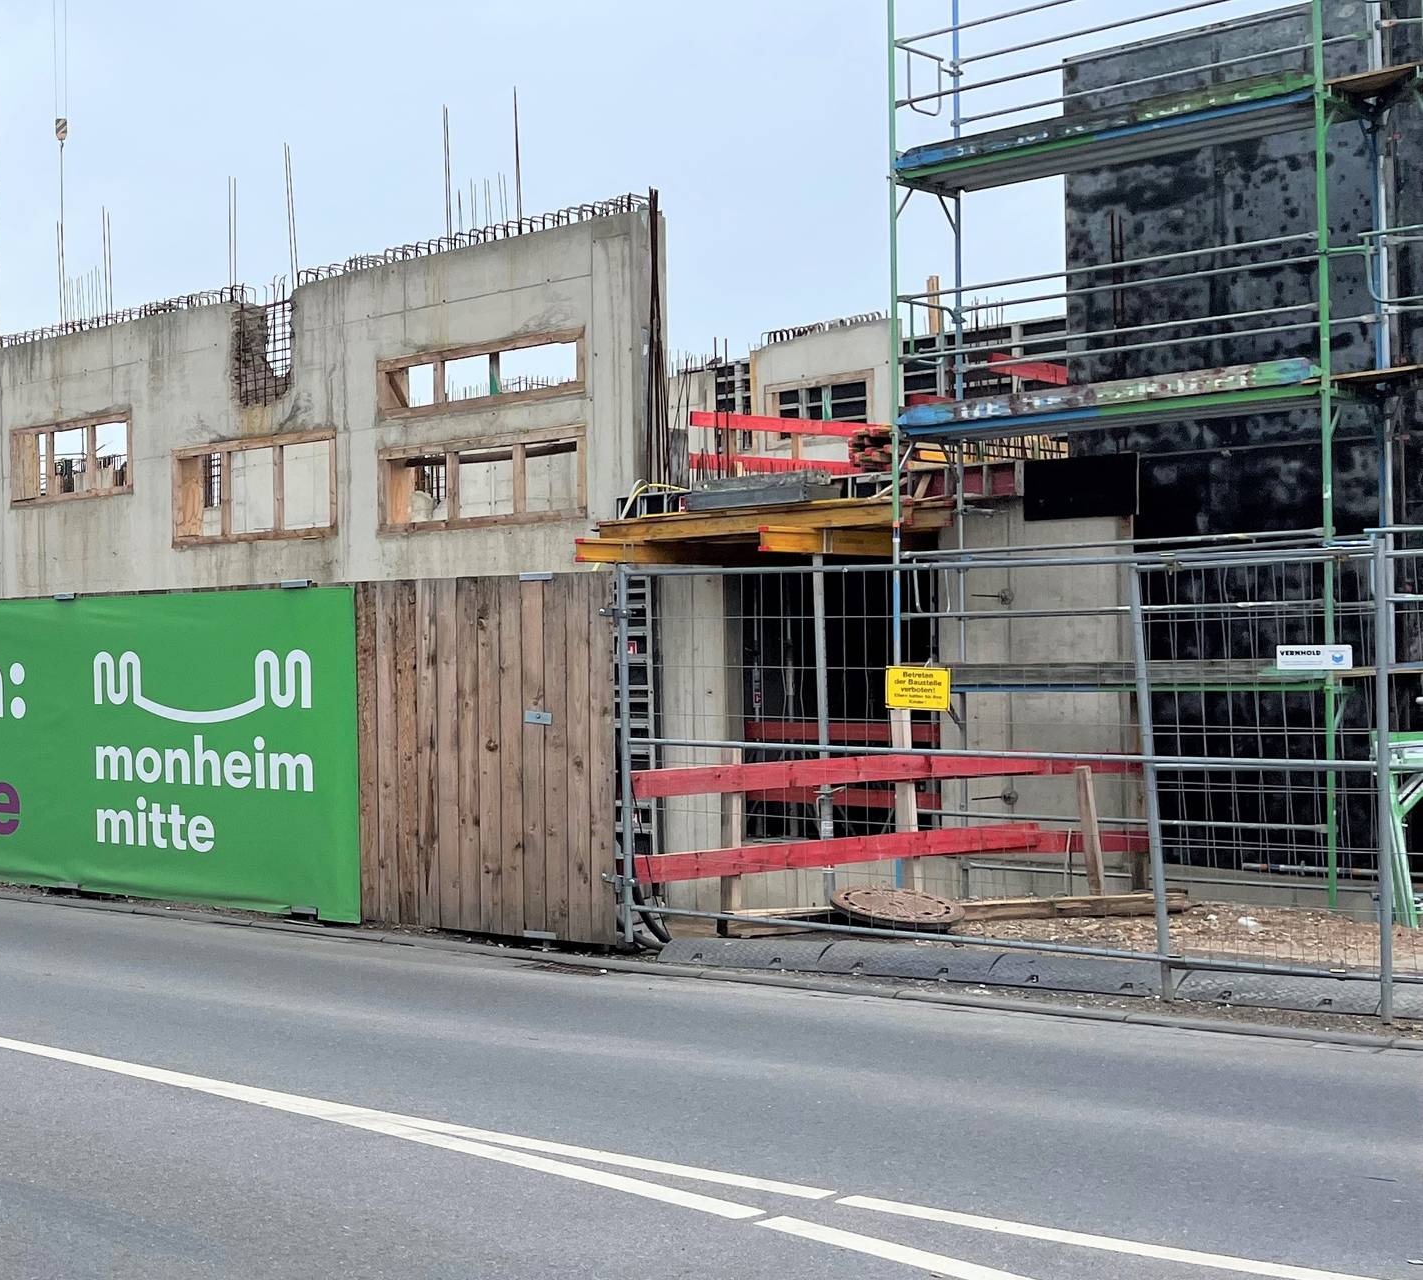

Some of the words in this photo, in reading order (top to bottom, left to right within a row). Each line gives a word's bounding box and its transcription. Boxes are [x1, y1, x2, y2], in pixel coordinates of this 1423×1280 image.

[908, 679, 942, 687] Baustelle
[95, 735, 314, 792] monheim
[96, 796, 215, 853] mitte
